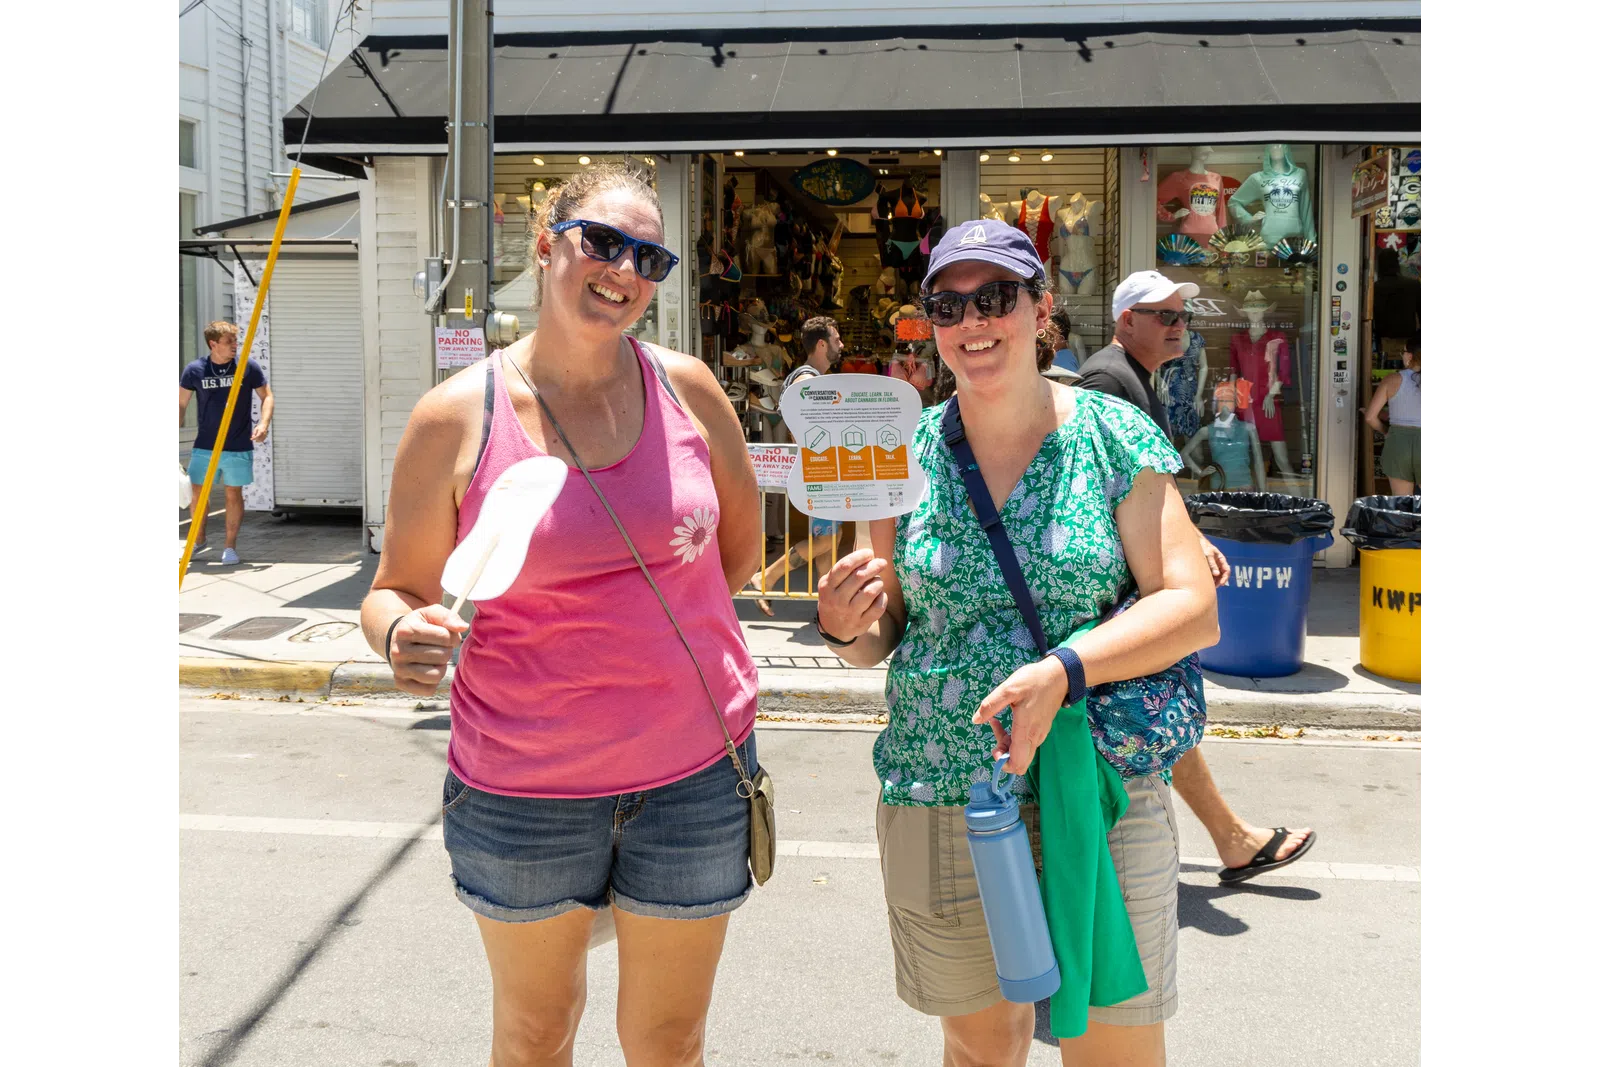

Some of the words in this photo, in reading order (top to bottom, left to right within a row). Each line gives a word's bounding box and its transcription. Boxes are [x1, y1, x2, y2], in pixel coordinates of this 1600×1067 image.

[455, 329, 470, 337] NO
[438, 337, 483, 345] PARKING
[201, 379, 219, 389] U.S.
[750, 454, 796, 464] PARKING
[1224, 565, 1292, 589] WPW
